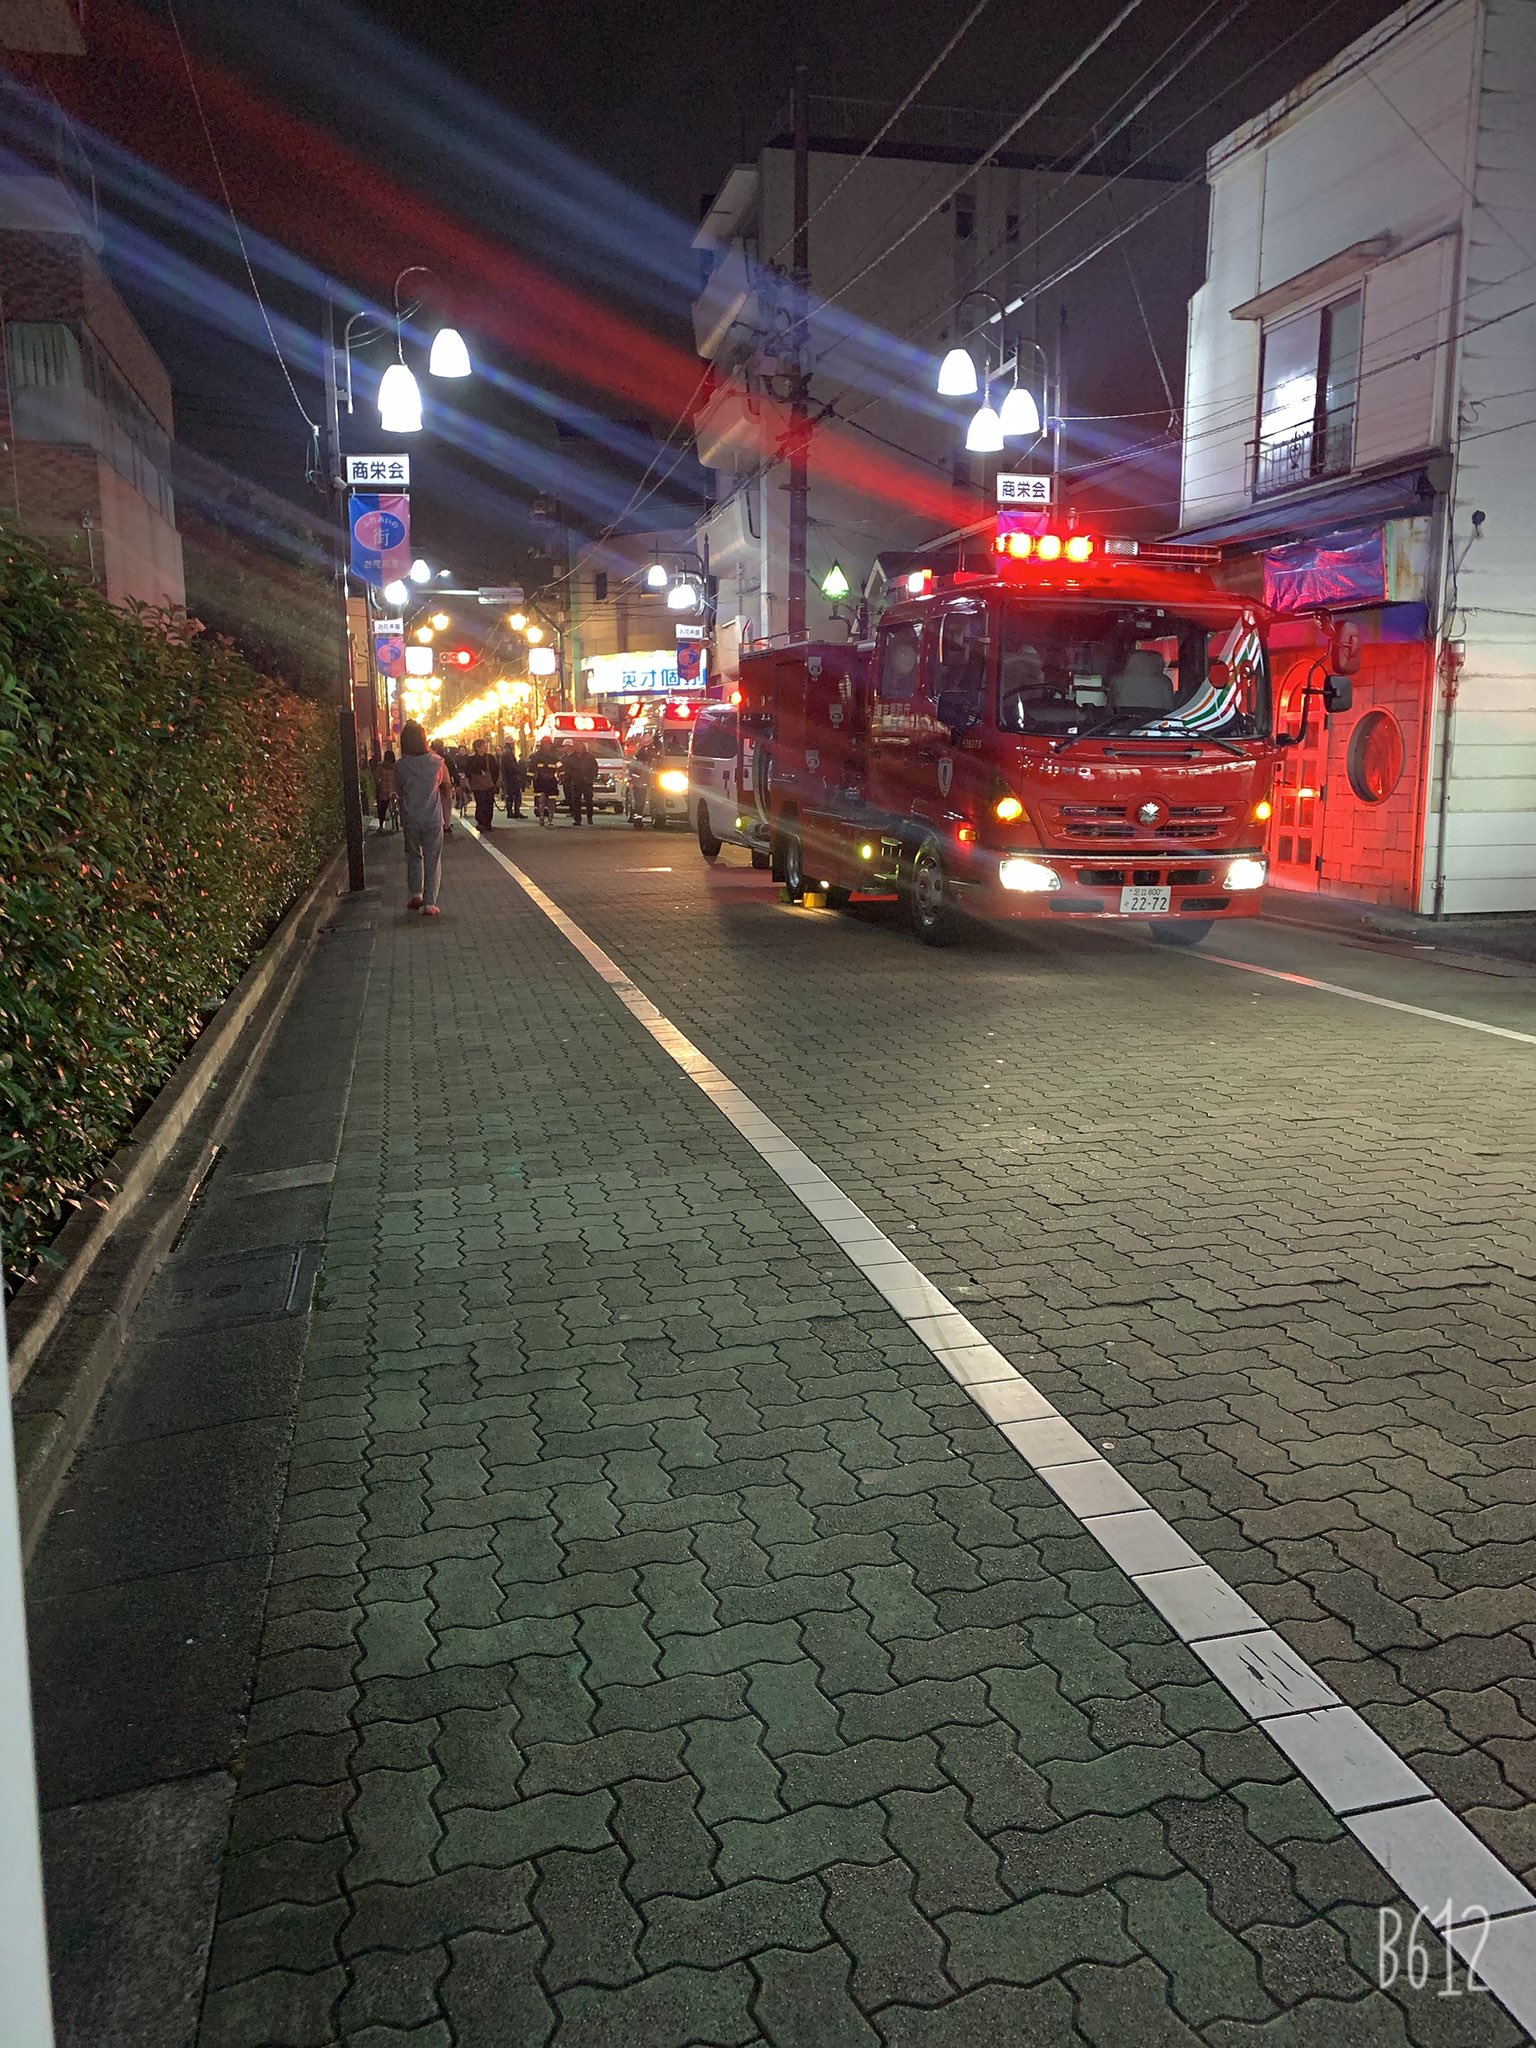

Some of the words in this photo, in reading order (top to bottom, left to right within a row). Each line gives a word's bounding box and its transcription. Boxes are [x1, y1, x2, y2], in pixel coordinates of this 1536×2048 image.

[352, 461, 404, 480] 商栄会
[1002, 480, 1046, 499] 商栄会
[373, 527, 390, 546] 街
[1131, 897, 1168, 910] 22-72
